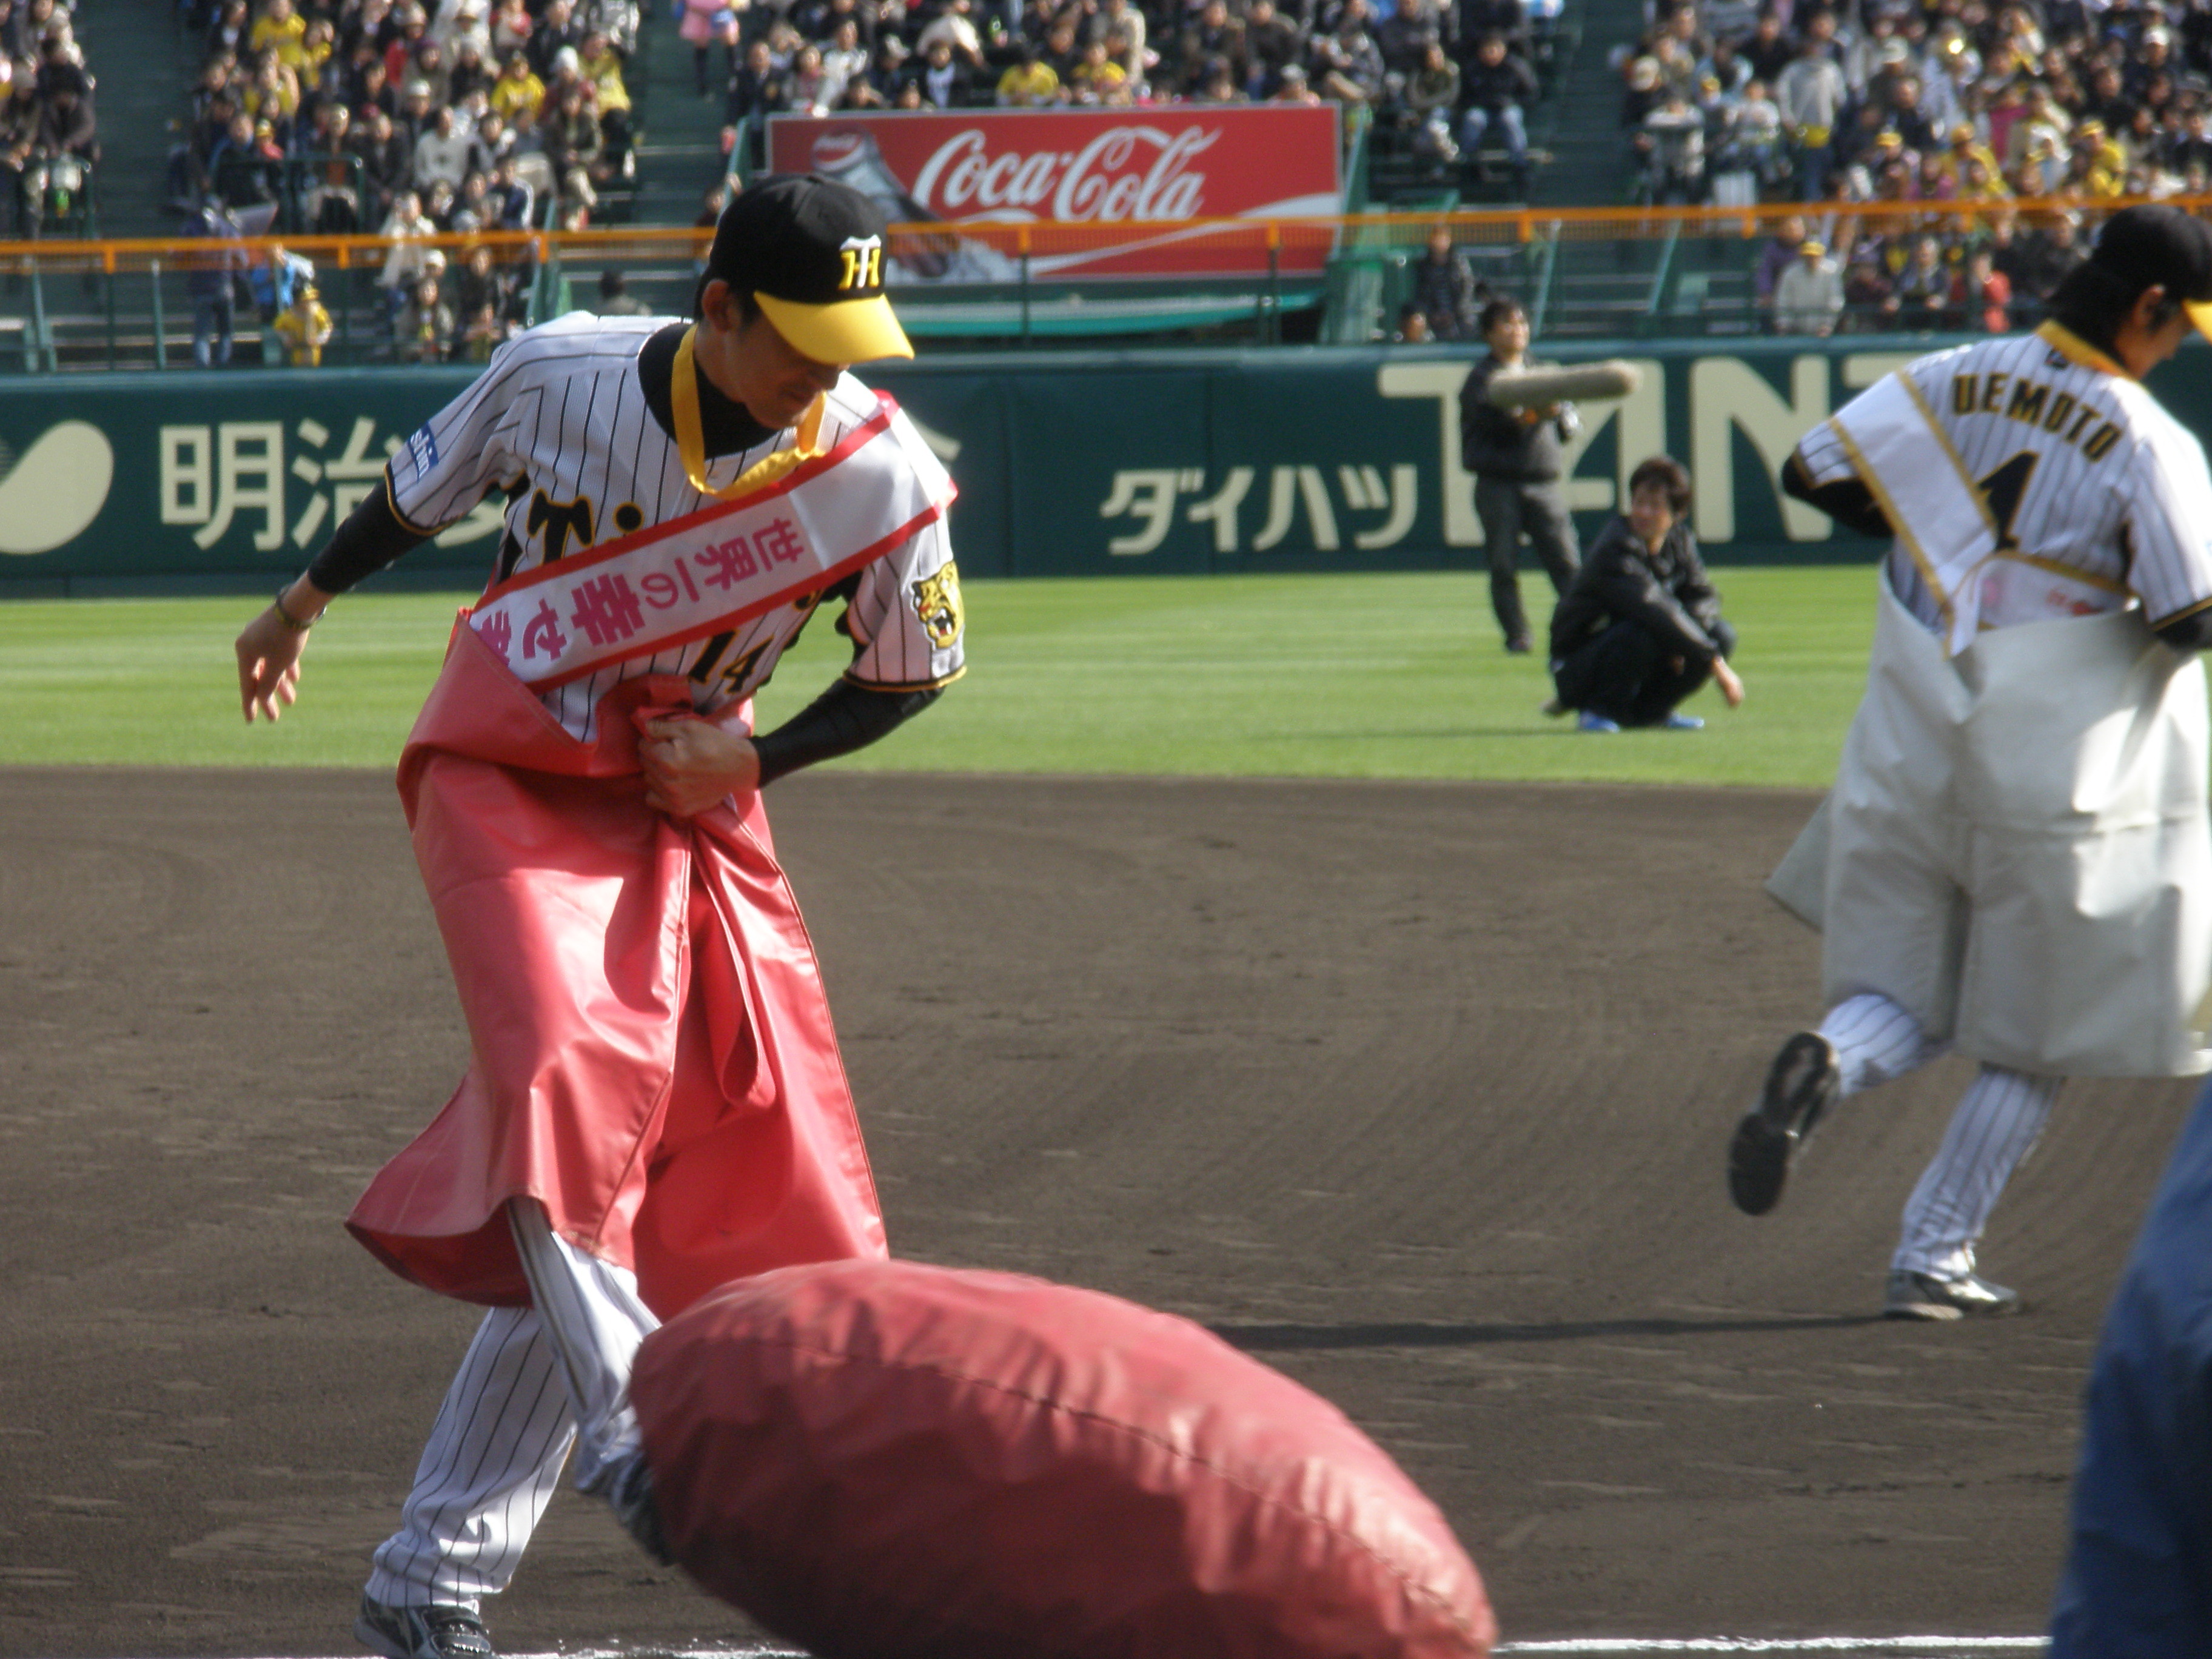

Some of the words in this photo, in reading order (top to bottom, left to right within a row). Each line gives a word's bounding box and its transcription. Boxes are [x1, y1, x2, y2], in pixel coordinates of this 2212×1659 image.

[911, 125, 1221, 223] Coca-Cola
[1952, 372, 2123, 464] UEMOTO
[1099, 463, 1418, 556] ダイハツ
[687, 628, 776, 695] 14
